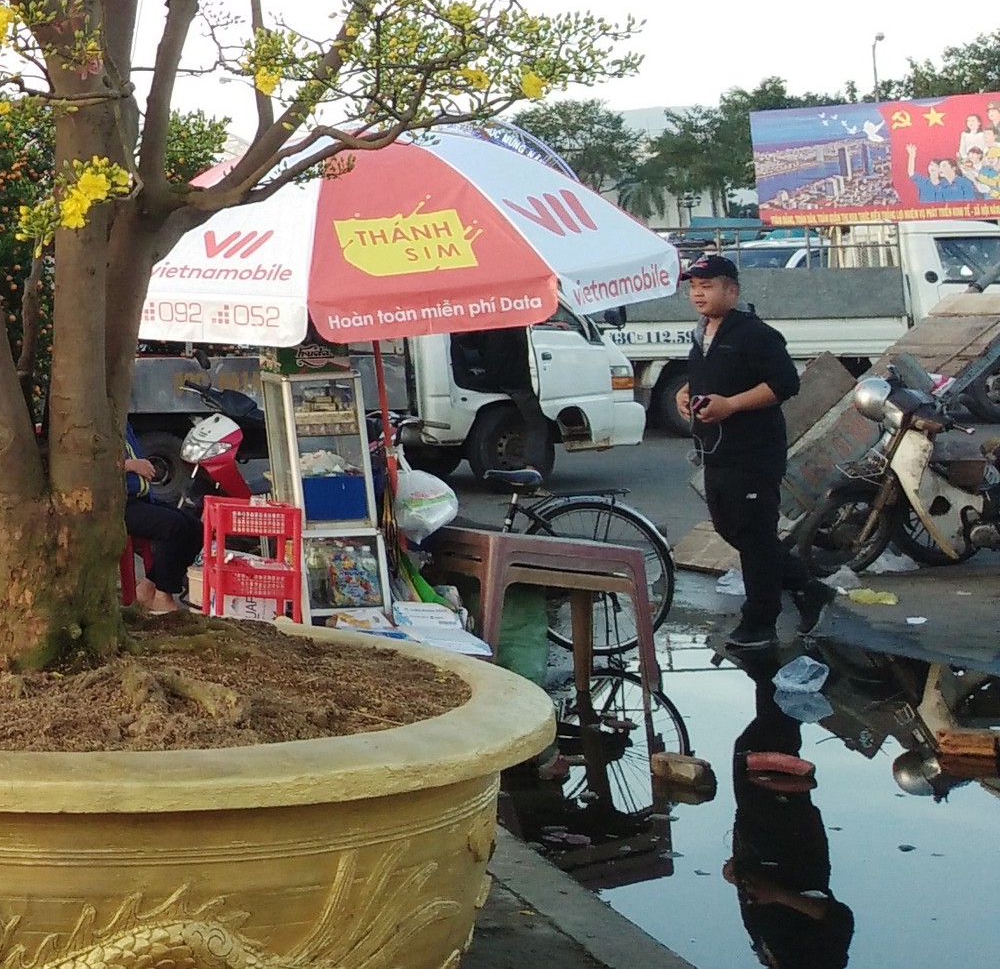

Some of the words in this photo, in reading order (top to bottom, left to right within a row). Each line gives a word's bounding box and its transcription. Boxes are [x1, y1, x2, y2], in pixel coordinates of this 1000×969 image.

[354, 221, 453, 247] THÁNH
[405, 243, 461, 262] SIM
[151, 261, 293, 281] vietnamobile
[572, 263, 671, 306] vietnamobile
[158, 302, 202, 323] 092
[233, 304, 280, 328] 052
[328, 310, 374, 329] Hoàn
[377, 306, 418, 324] toàn
[421, 299, 464, 320] miễn
[468, 296, 496, 317] phí
[501, 294, 542, 312] Data
